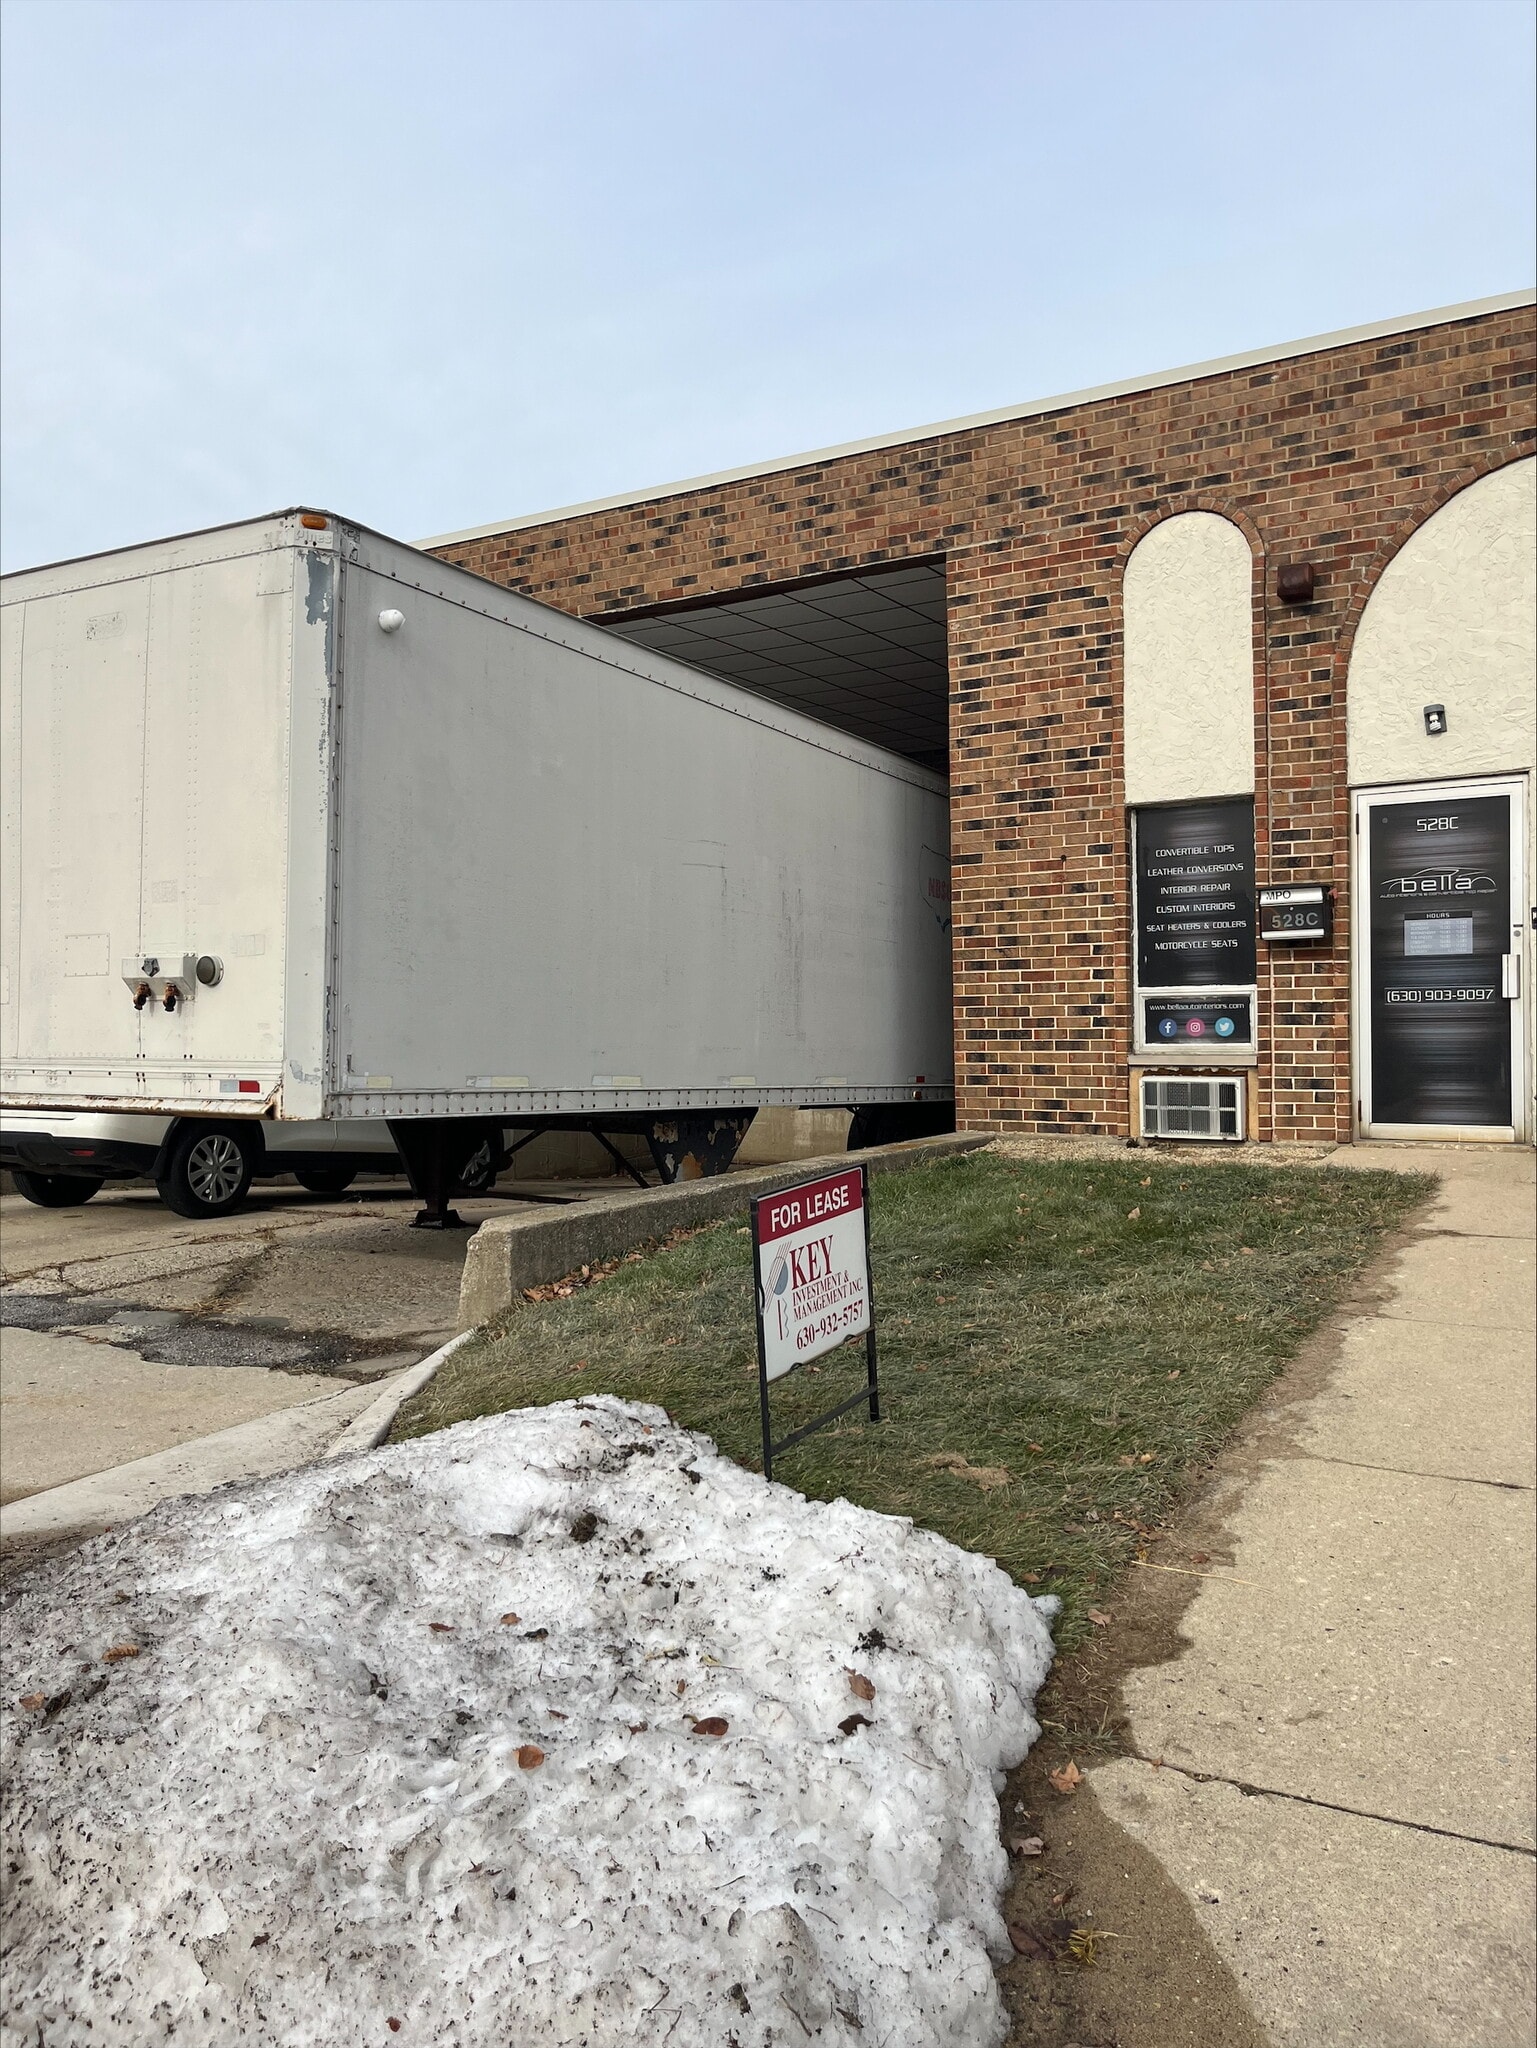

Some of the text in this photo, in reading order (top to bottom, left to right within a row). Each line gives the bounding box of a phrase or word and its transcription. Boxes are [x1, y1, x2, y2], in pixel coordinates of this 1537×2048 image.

[1416, 816, 1459, 832] 528C
[1155, 844, 1235, 858] CONVERTIBLE TOPS
[1147, 863, 1244, 877] LEATHER CONVERSIONS
[1160, 883, 1231, 895] INTERIOR REPAIR
[1401, 874, 1472, 893] bella
[1266, 890, 1291, 900] MPO
[1156, 902, 1236, 914] CUSTOM INTERIORS
[1146, 920, 1247, 932] SEAT HEATERS & COOLERS
[1271, 912, 1319, 929] 528C
[1155, 939, 1239, 951] MOTORCYCLE SEATS
[1387, 988, 1495, 1003] (630) 903-9097
[1149, 1003, 1245, 1011] www.bellaautointeriors.com
[771, 1184, 850, 1233] FOR LEASE
[789, 1234, 834, 1291] KEY
[792, 1270, 850, 1307] INVESTMENT &
[793, 1277, 864, 1322] MANAGEMENT INC.
[796, 1299, 864, 1350] 630-932-5757
